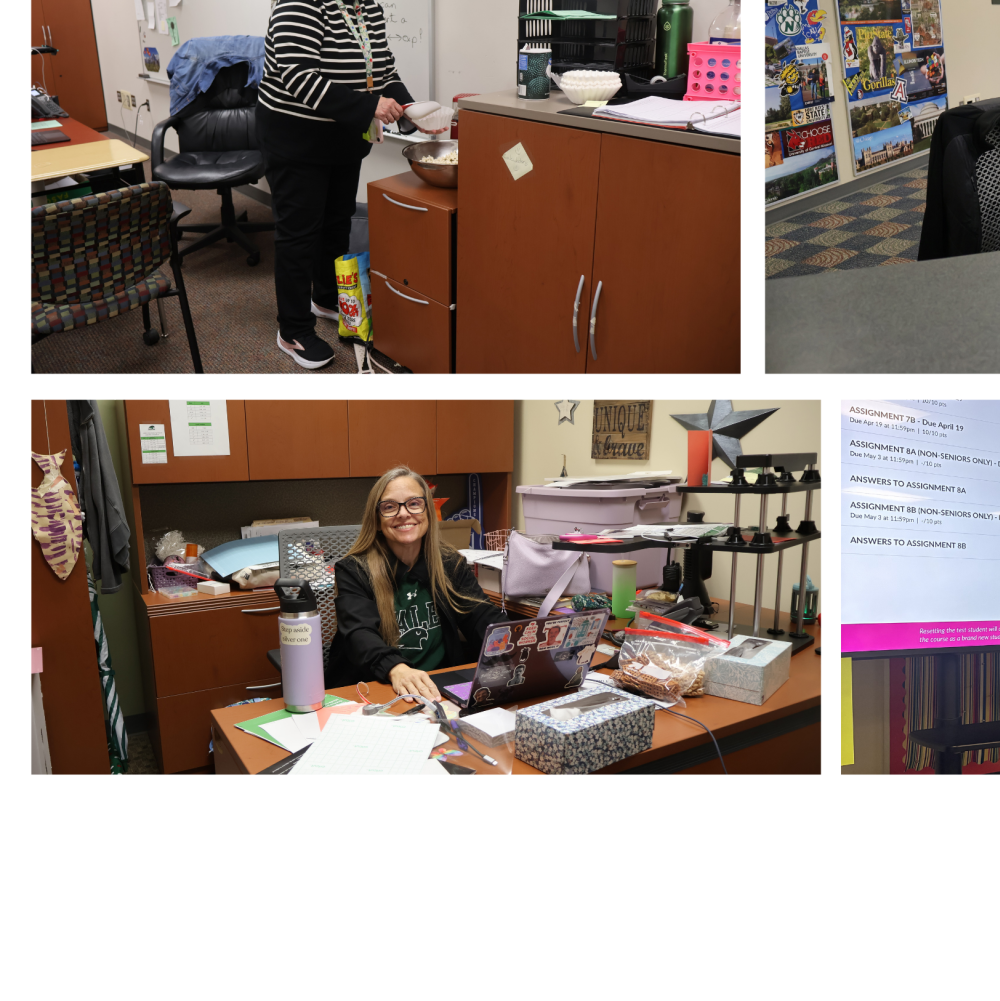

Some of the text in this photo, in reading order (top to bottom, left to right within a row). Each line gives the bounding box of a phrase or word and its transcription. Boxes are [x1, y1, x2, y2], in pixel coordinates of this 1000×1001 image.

[785, 21, 794, 32] N
[863, 77, 895, 91] Gorillas
[891, 79, 907, 102] A
[805, 110, 825, 120] STATE
[801, 125, 831, 139] CHOOSE
[595, 403, 645, 437] UNIQUE
[849, 406, 904, 421] ASSIGNMENT
[922, 419, 936, 427] Due
[938, 422, 954, 431] April
[891, 424, 915, 433] 11:59pm
[922, 429, 938, 437] 10/10
[603, 435, 645, 457] brave
[850, 440, 904, 453] ASSIGNMENT
[906, 448, 917, 456] 8A
[918, 449, 971, 463] (NON-SENIORS
[972, 457, 993, 467] ONLY)
[863, 452, 876, 460] May
[890, 456, 914, 465] 11:59pm
[850, 475, 966, 494] ANSWERS TO ASSIGNMENT 8A
[850, 501, 905, 513] ASSIGNMENT
[906, 506, 916, 514] 8B
[918, 507, 972, 519] (NON-SENIORS
[972, 512, 994, 521] ONLY)
[890, 516, 914, 524] 11:59pm
[850, 536, 892, 546] ANSWERS
[893, 538, 905, 546] TO
[906, 539, 956, 549] ASSIGNMENT
[281, 626, 292, 634] Step
[919, 627, 945, 635] Resetting
